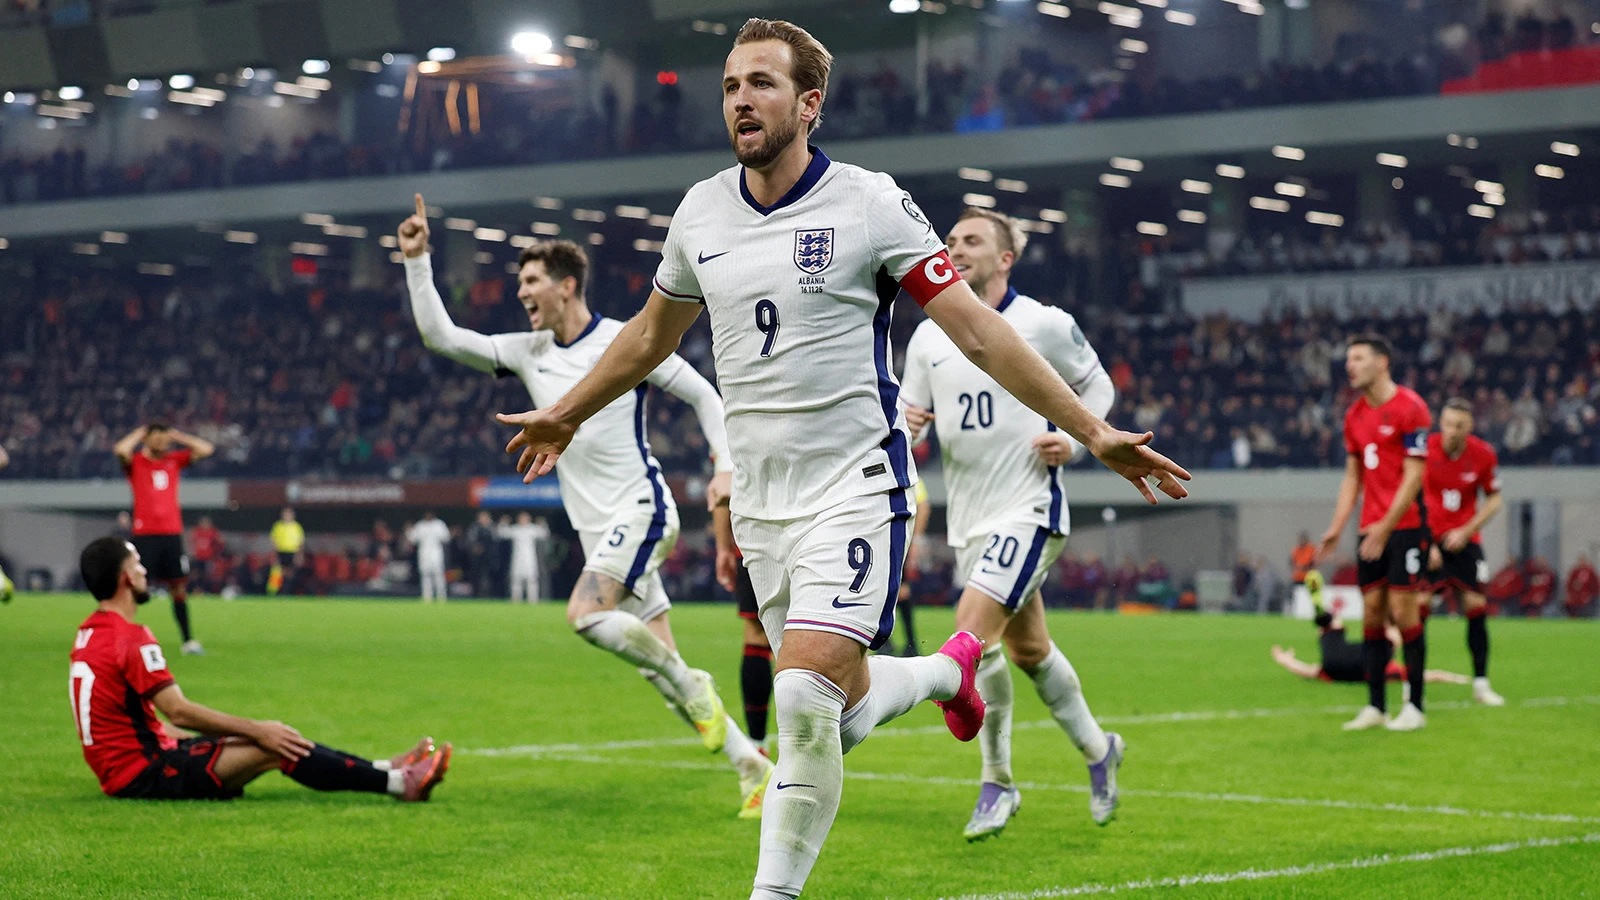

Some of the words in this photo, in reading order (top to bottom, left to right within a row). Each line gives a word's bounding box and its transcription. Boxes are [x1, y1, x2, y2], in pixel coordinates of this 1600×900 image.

[924, 256, 953, 285] C
[801, 286, 823, 294] 16.11.25
[755, 299, 780, 358] 9
[958, 390, 993, 430] 20
[1363, 443, 1380, 470] 6
[608, 524, 630, 547] 5
[848, 538, 873, 594] 9
[982, 534, 1019, 569] 20
[1405, 548, 1420, 575] 6
